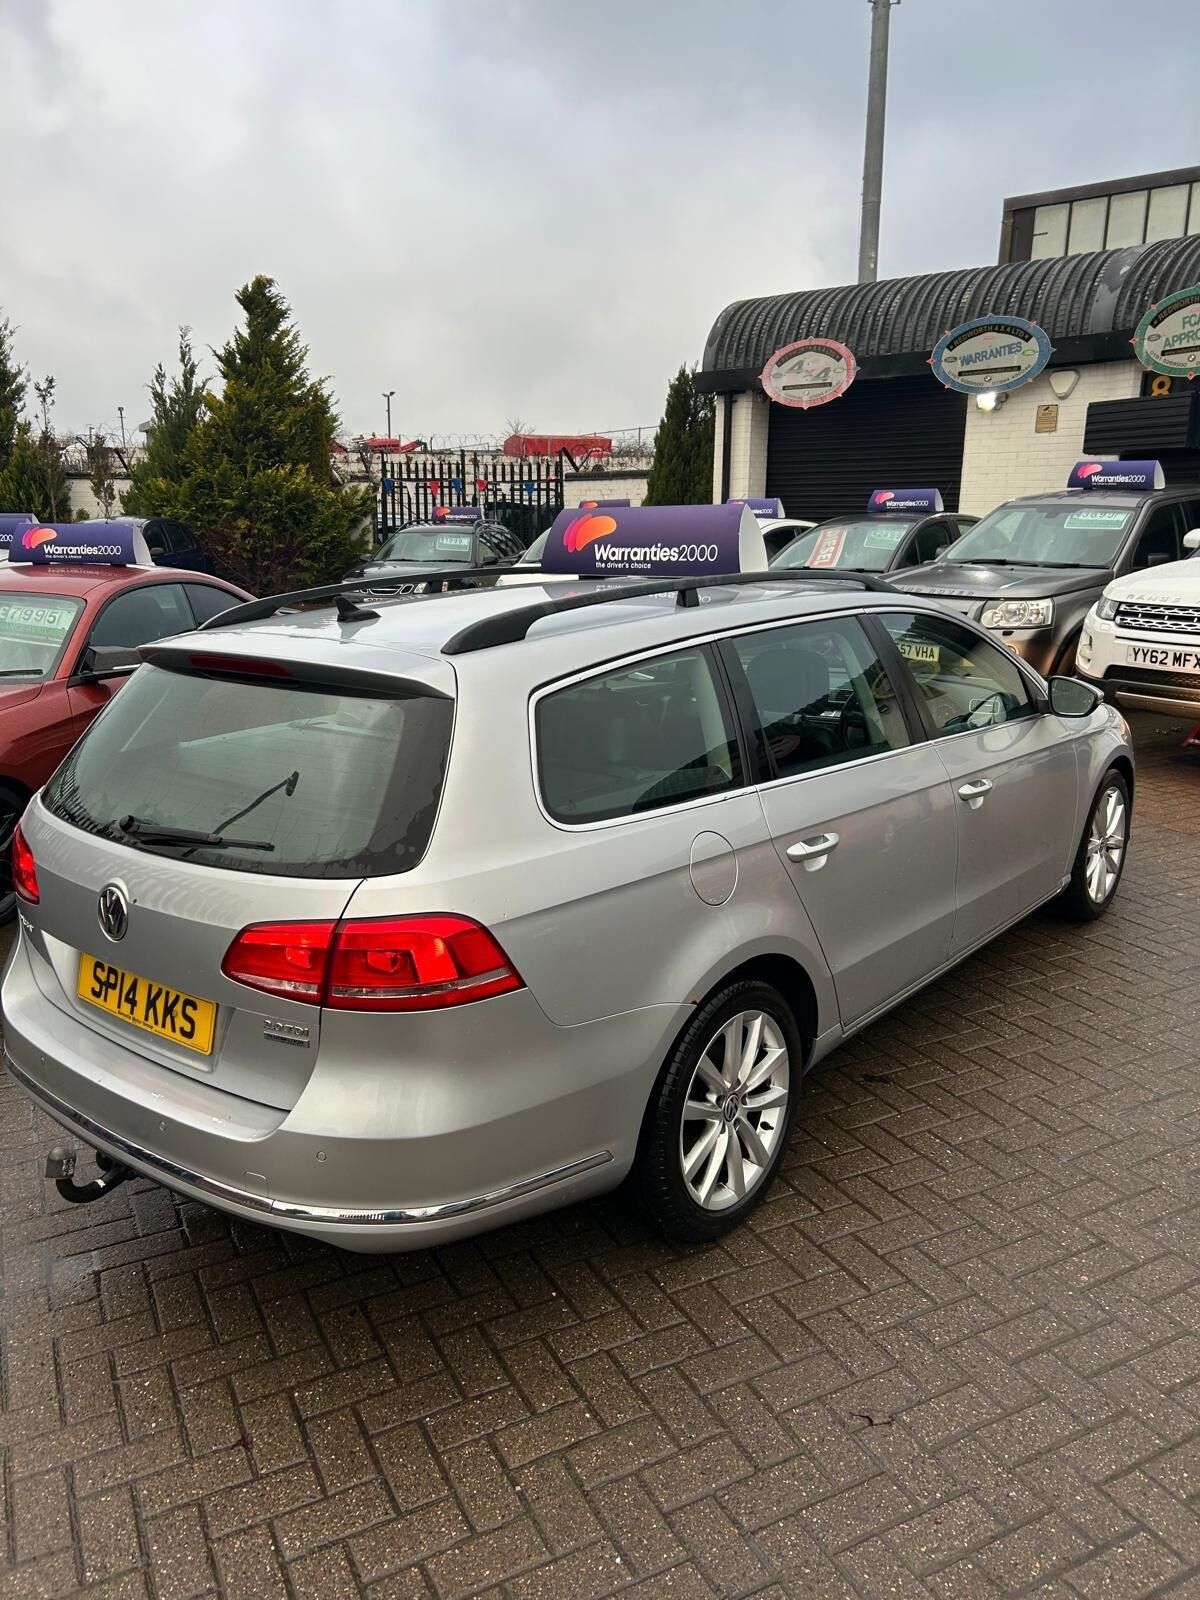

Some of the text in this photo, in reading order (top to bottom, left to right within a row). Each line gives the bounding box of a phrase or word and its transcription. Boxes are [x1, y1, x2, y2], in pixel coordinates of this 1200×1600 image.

[1157, 296, 1200, 321] REDWORTH
[953, 325, 993, 346] REDWORTH
[1011, 327, 1025, 337] LTD
[959, 341, 1022, 366] WARRANTIES
[1091, 474, 1146, 483] Warranties2000
[43, 544, 121, 556] Warranties2000
[594, 543, 718, 561] Warranties2000
[814, 528, 841, 566] DIESEL
[1126, 594, 1182, 604] RANGE
[915, 645, 935, 659] VHA
[1133, 648, 1200, 668] YY62 MFX
[91, 960, 198, 1040] SP14 KKS
